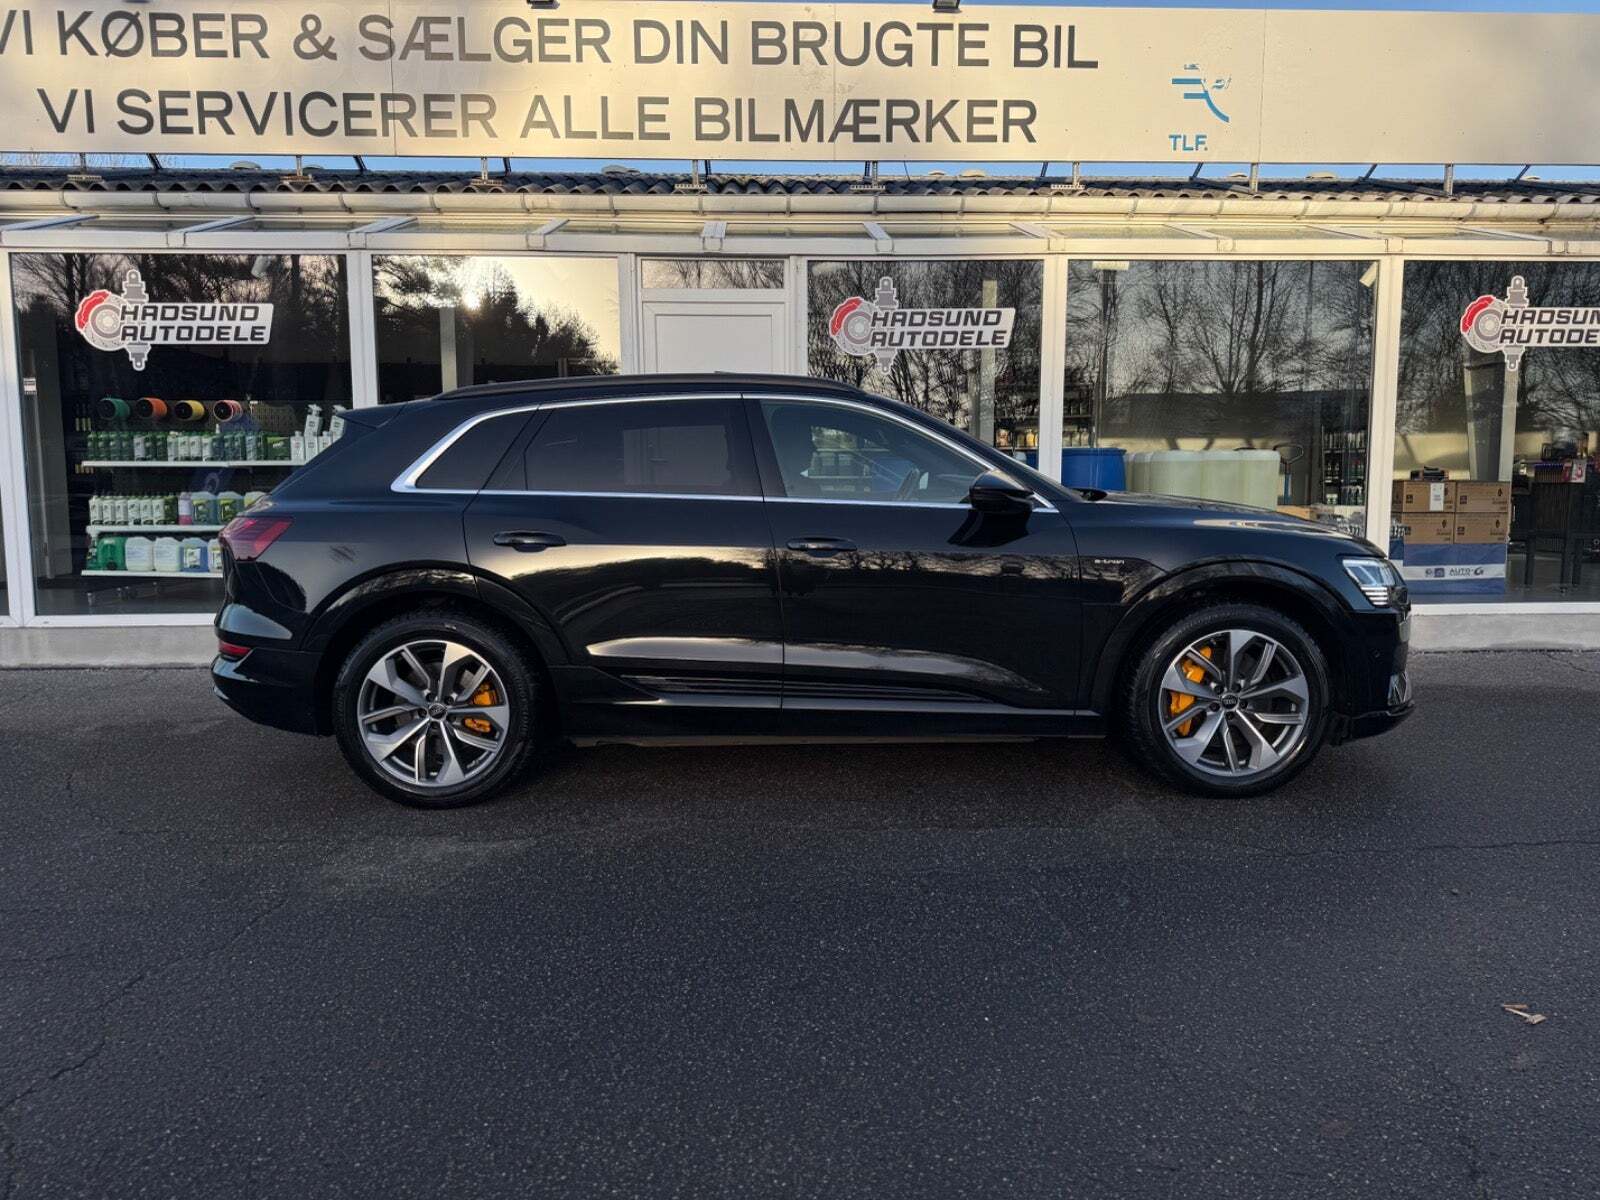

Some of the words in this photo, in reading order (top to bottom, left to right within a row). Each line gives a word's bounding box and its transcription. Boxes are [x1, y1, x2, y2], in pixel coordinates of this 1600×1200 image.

[57, 10, 270, 59] KØBER
[293, 14, 338, 61] &
[358, 15, 611, 63] SÆLGER
[633, 20, 729, 65] DIN
[752, 21, 990, 67] BRUGTE
[1014, 24, 1099, 69] BIL
[37, 88, 95, 134] VI
[116, 89, 498, 138] SERVICERER
[520, 95, 670, 141] ALLE
[695, 97, 1038, 144] BILMÆRKER
[1168, 134, 1208, 151] TLF.
[120, 305, 259, 321] HADSUND
[870, 310, 1002, 327] HADSUND
[120, 325, 266, 341] AUTODELE
[869, 330, 1007, 347] AUTODELE
[1499, 329, 1600, 344] AUTODE
